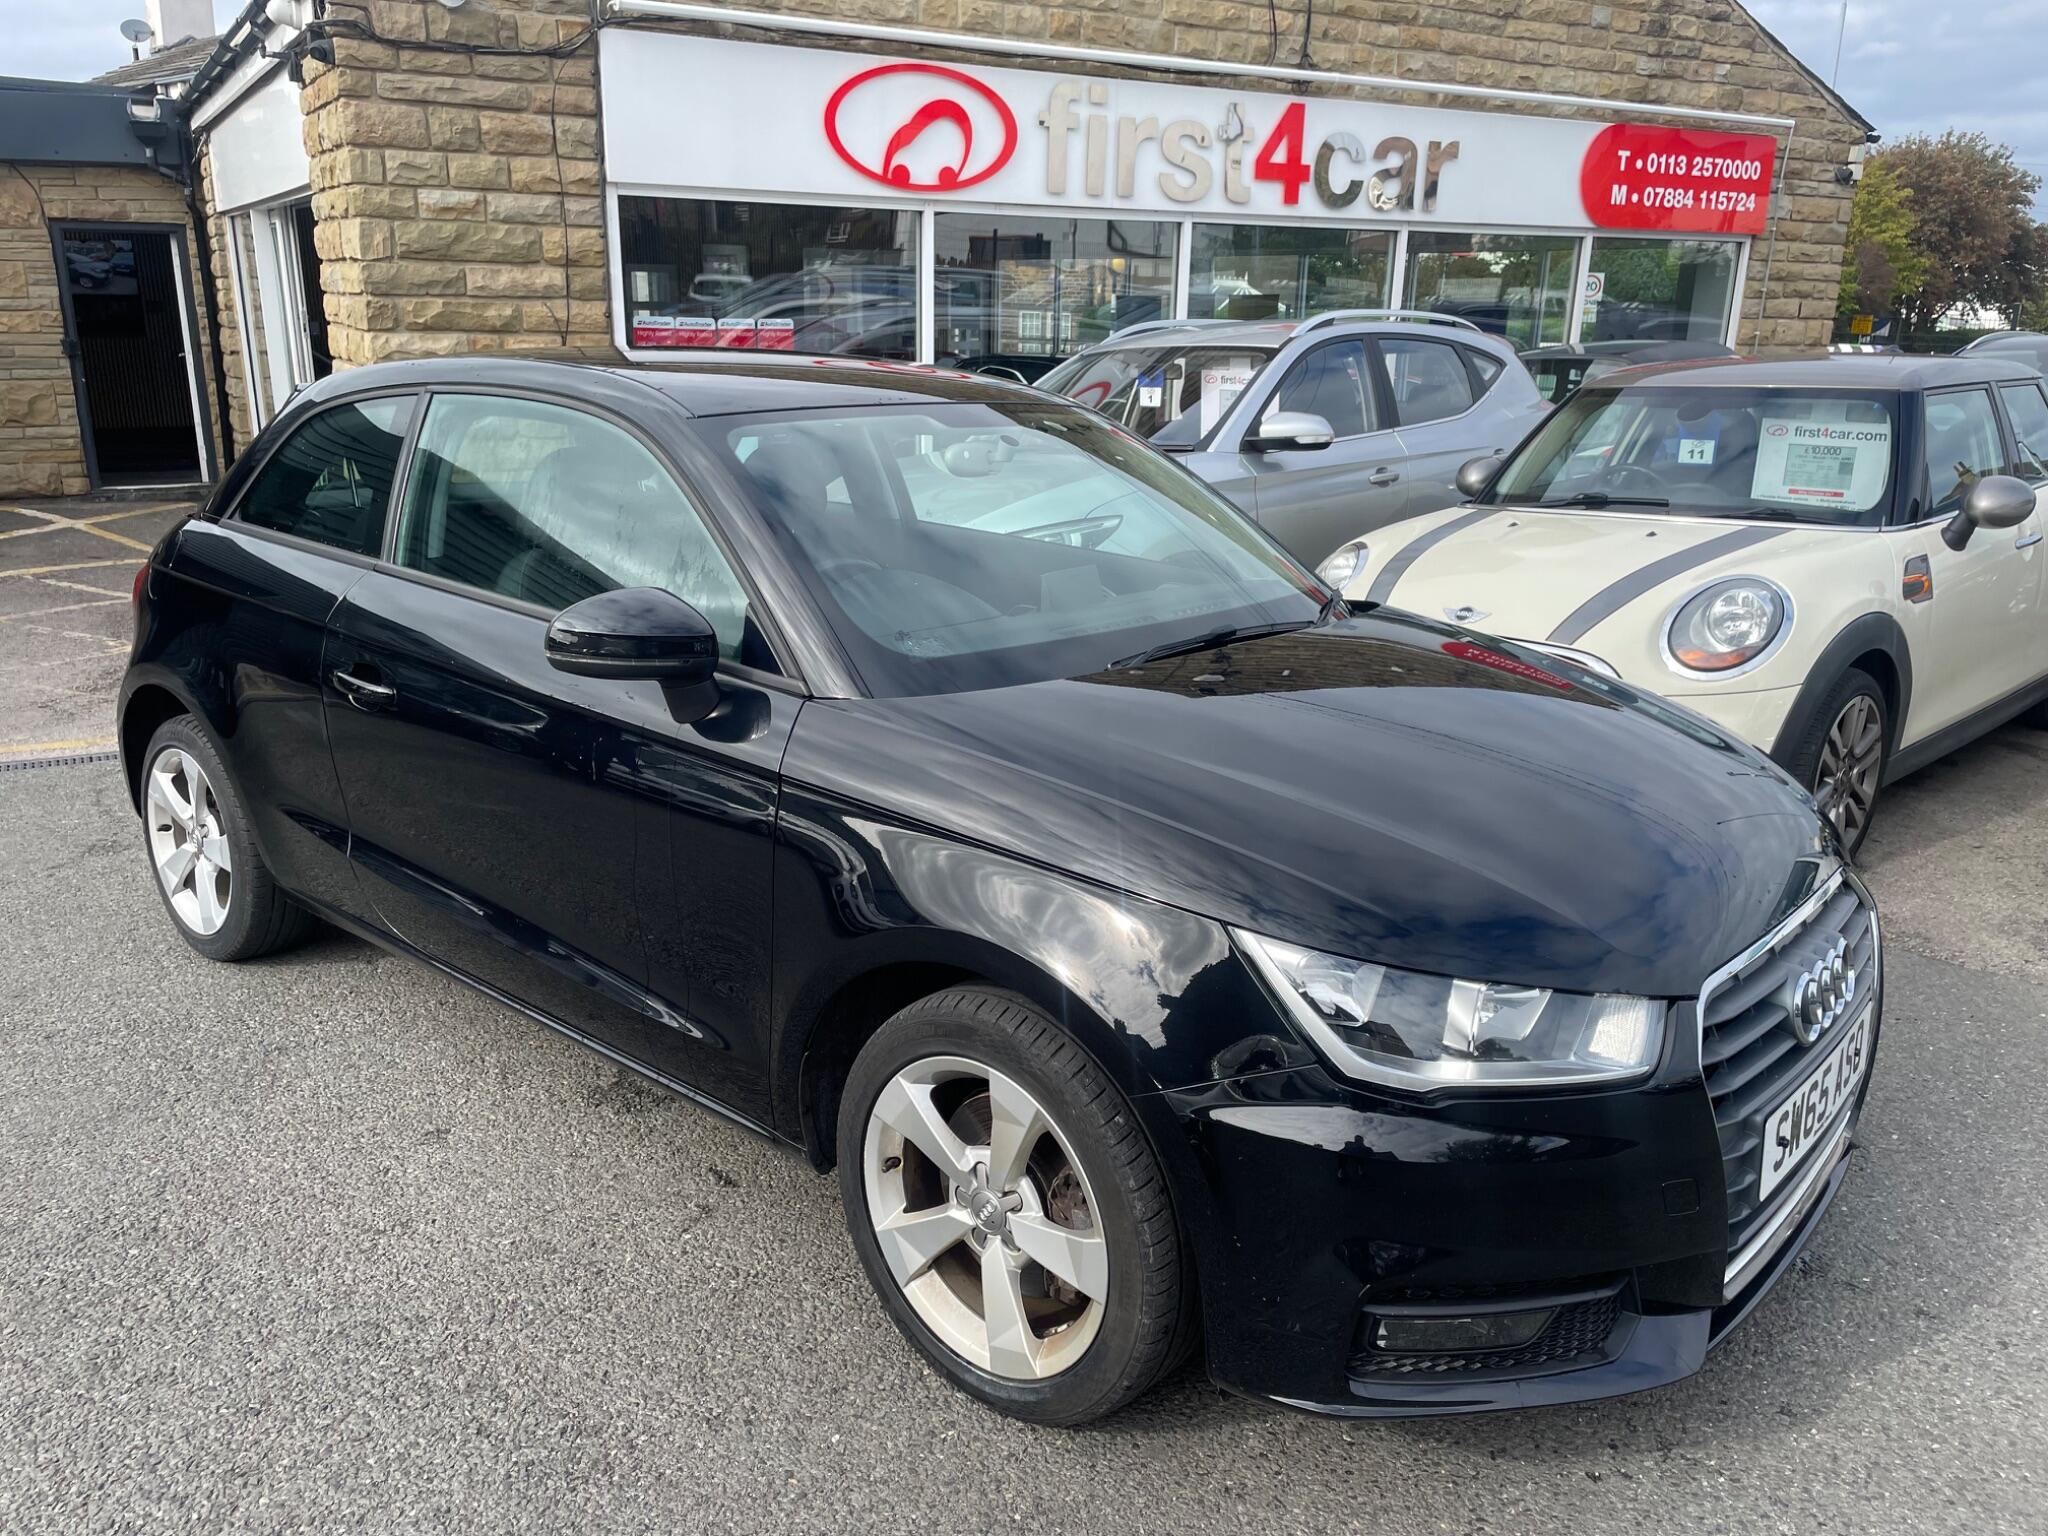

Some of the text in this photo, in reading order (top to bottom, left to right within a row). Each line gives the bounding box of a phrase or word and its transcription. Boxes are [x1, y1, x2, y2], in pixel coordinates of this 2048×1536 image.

[1038, 82, 1460, 214] first4car
[1617, 150, 1761, 180] T 0113 2570000
[1610, 184, 1756, 211] M 07884 115724
[1794, 426, 1887, 442] first4car.com
[1687, 449, 1705, 460] 11
[1773, 1062, 1832, 1173] SW65
